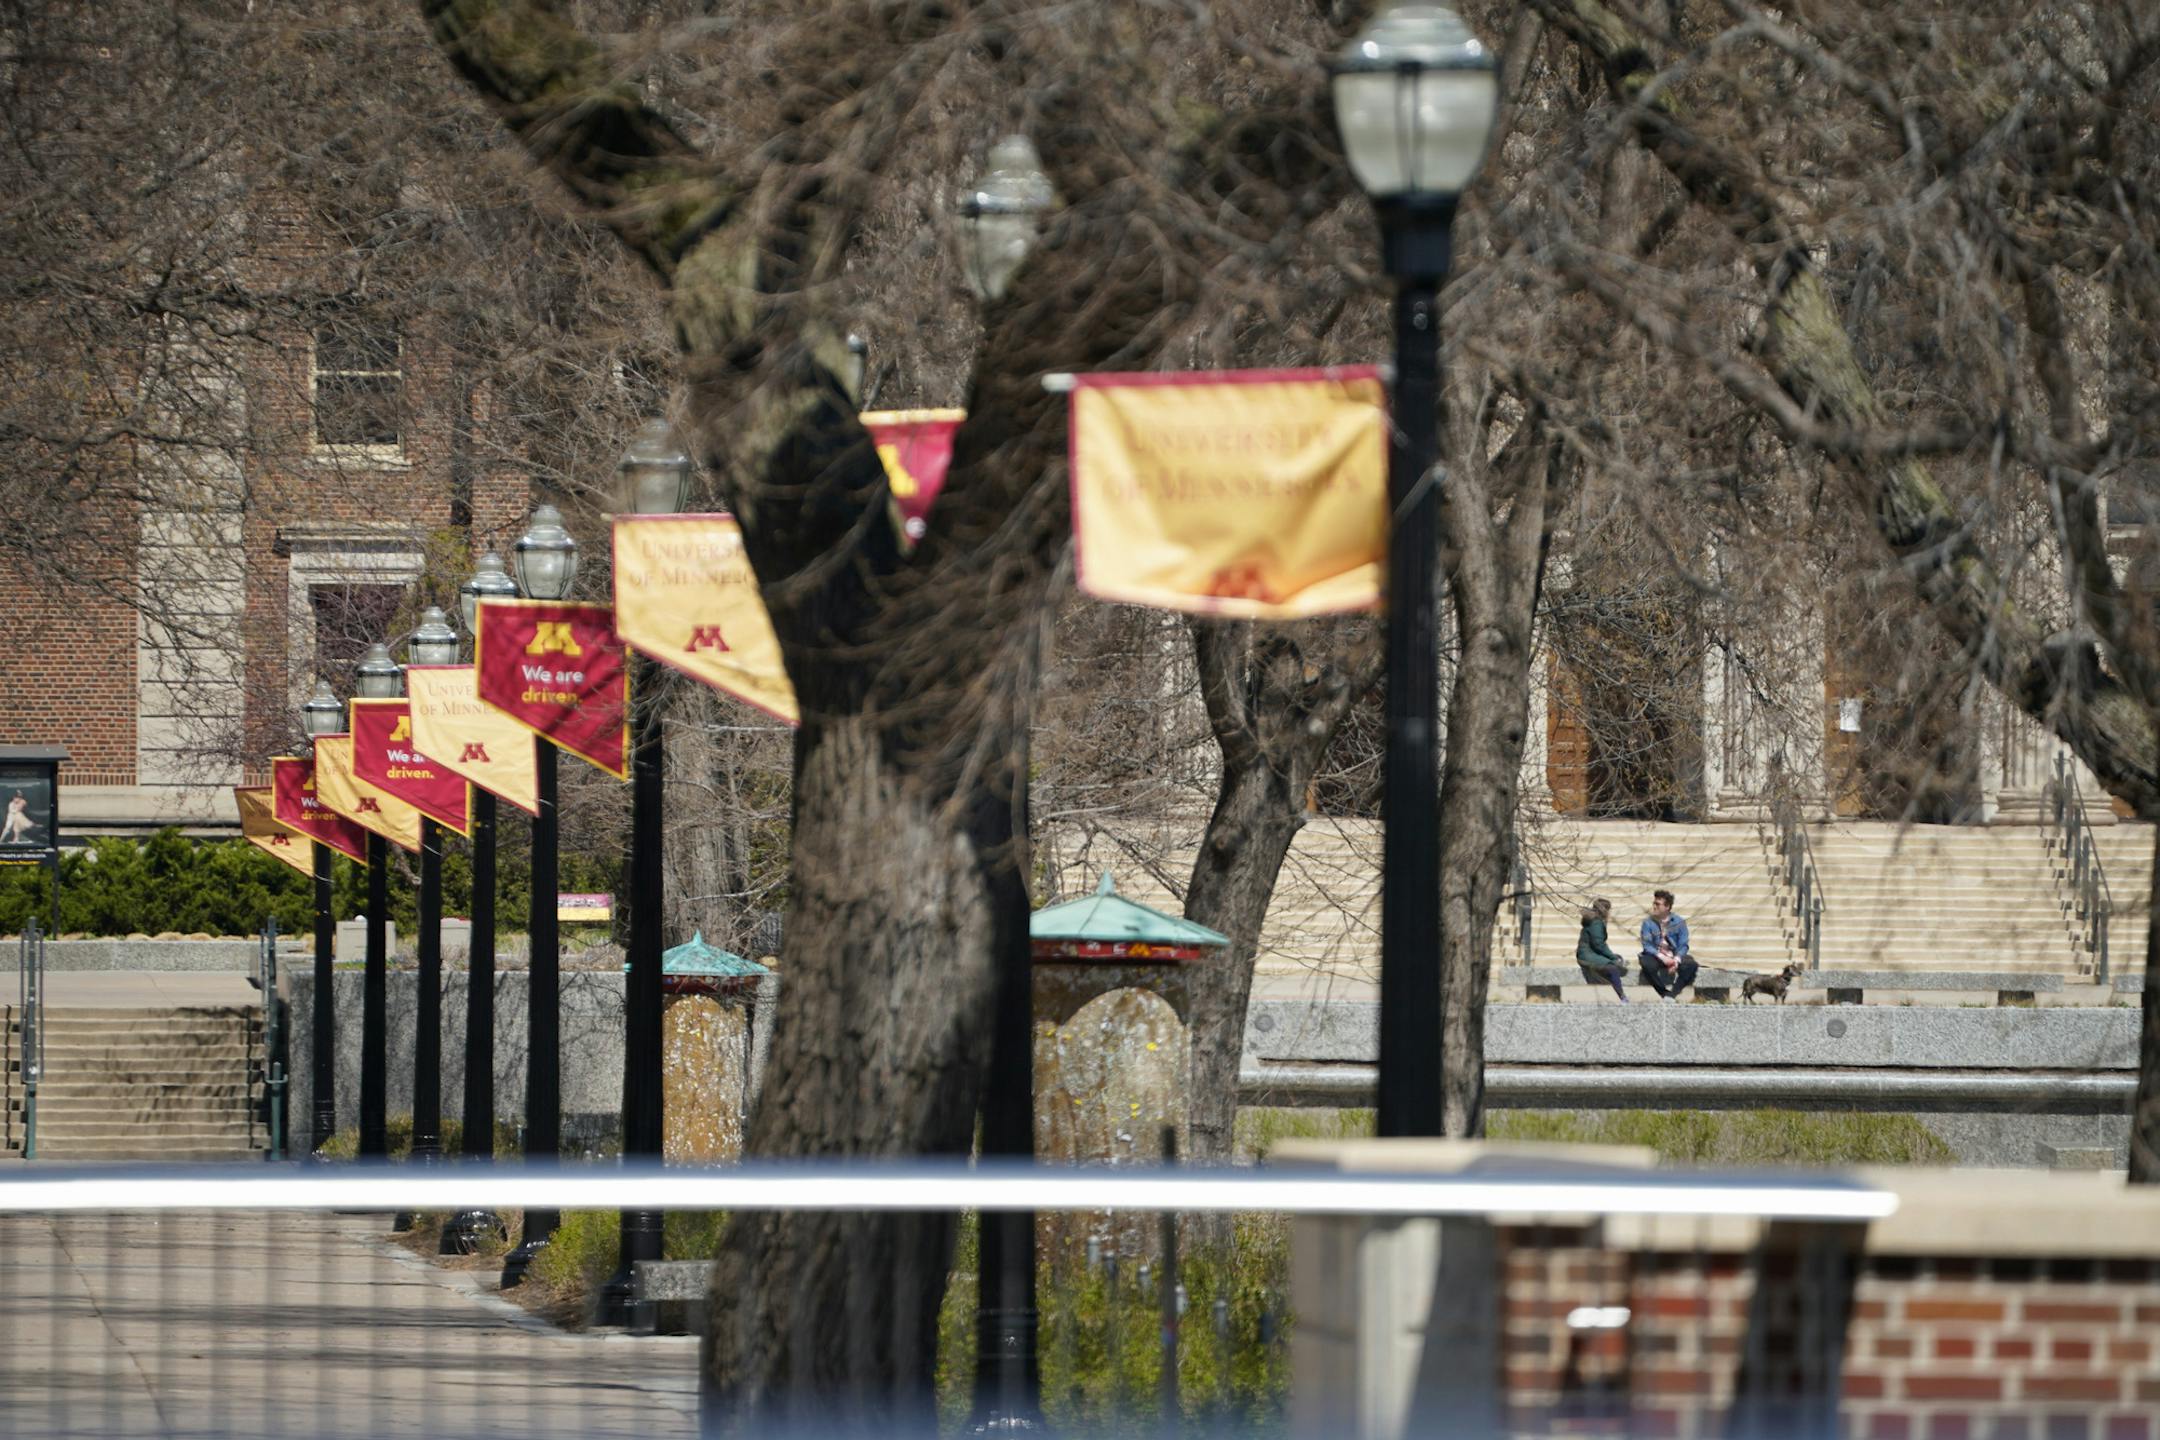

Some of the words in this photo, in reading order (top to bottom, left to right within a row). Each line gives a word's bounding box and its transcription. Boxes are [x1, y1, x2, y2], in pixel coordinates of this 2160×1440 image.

[525, 621, 583, 656] M
[684, 625, 731, 651] M
[521, 664, 553, 683] We
[555, 670, 585, 683] are
[420, 704, 437, 716] OF
[386, 749, 409, 763] We
[459, 742, 490, 763] M
[386, 765, 435, 779] driven.
